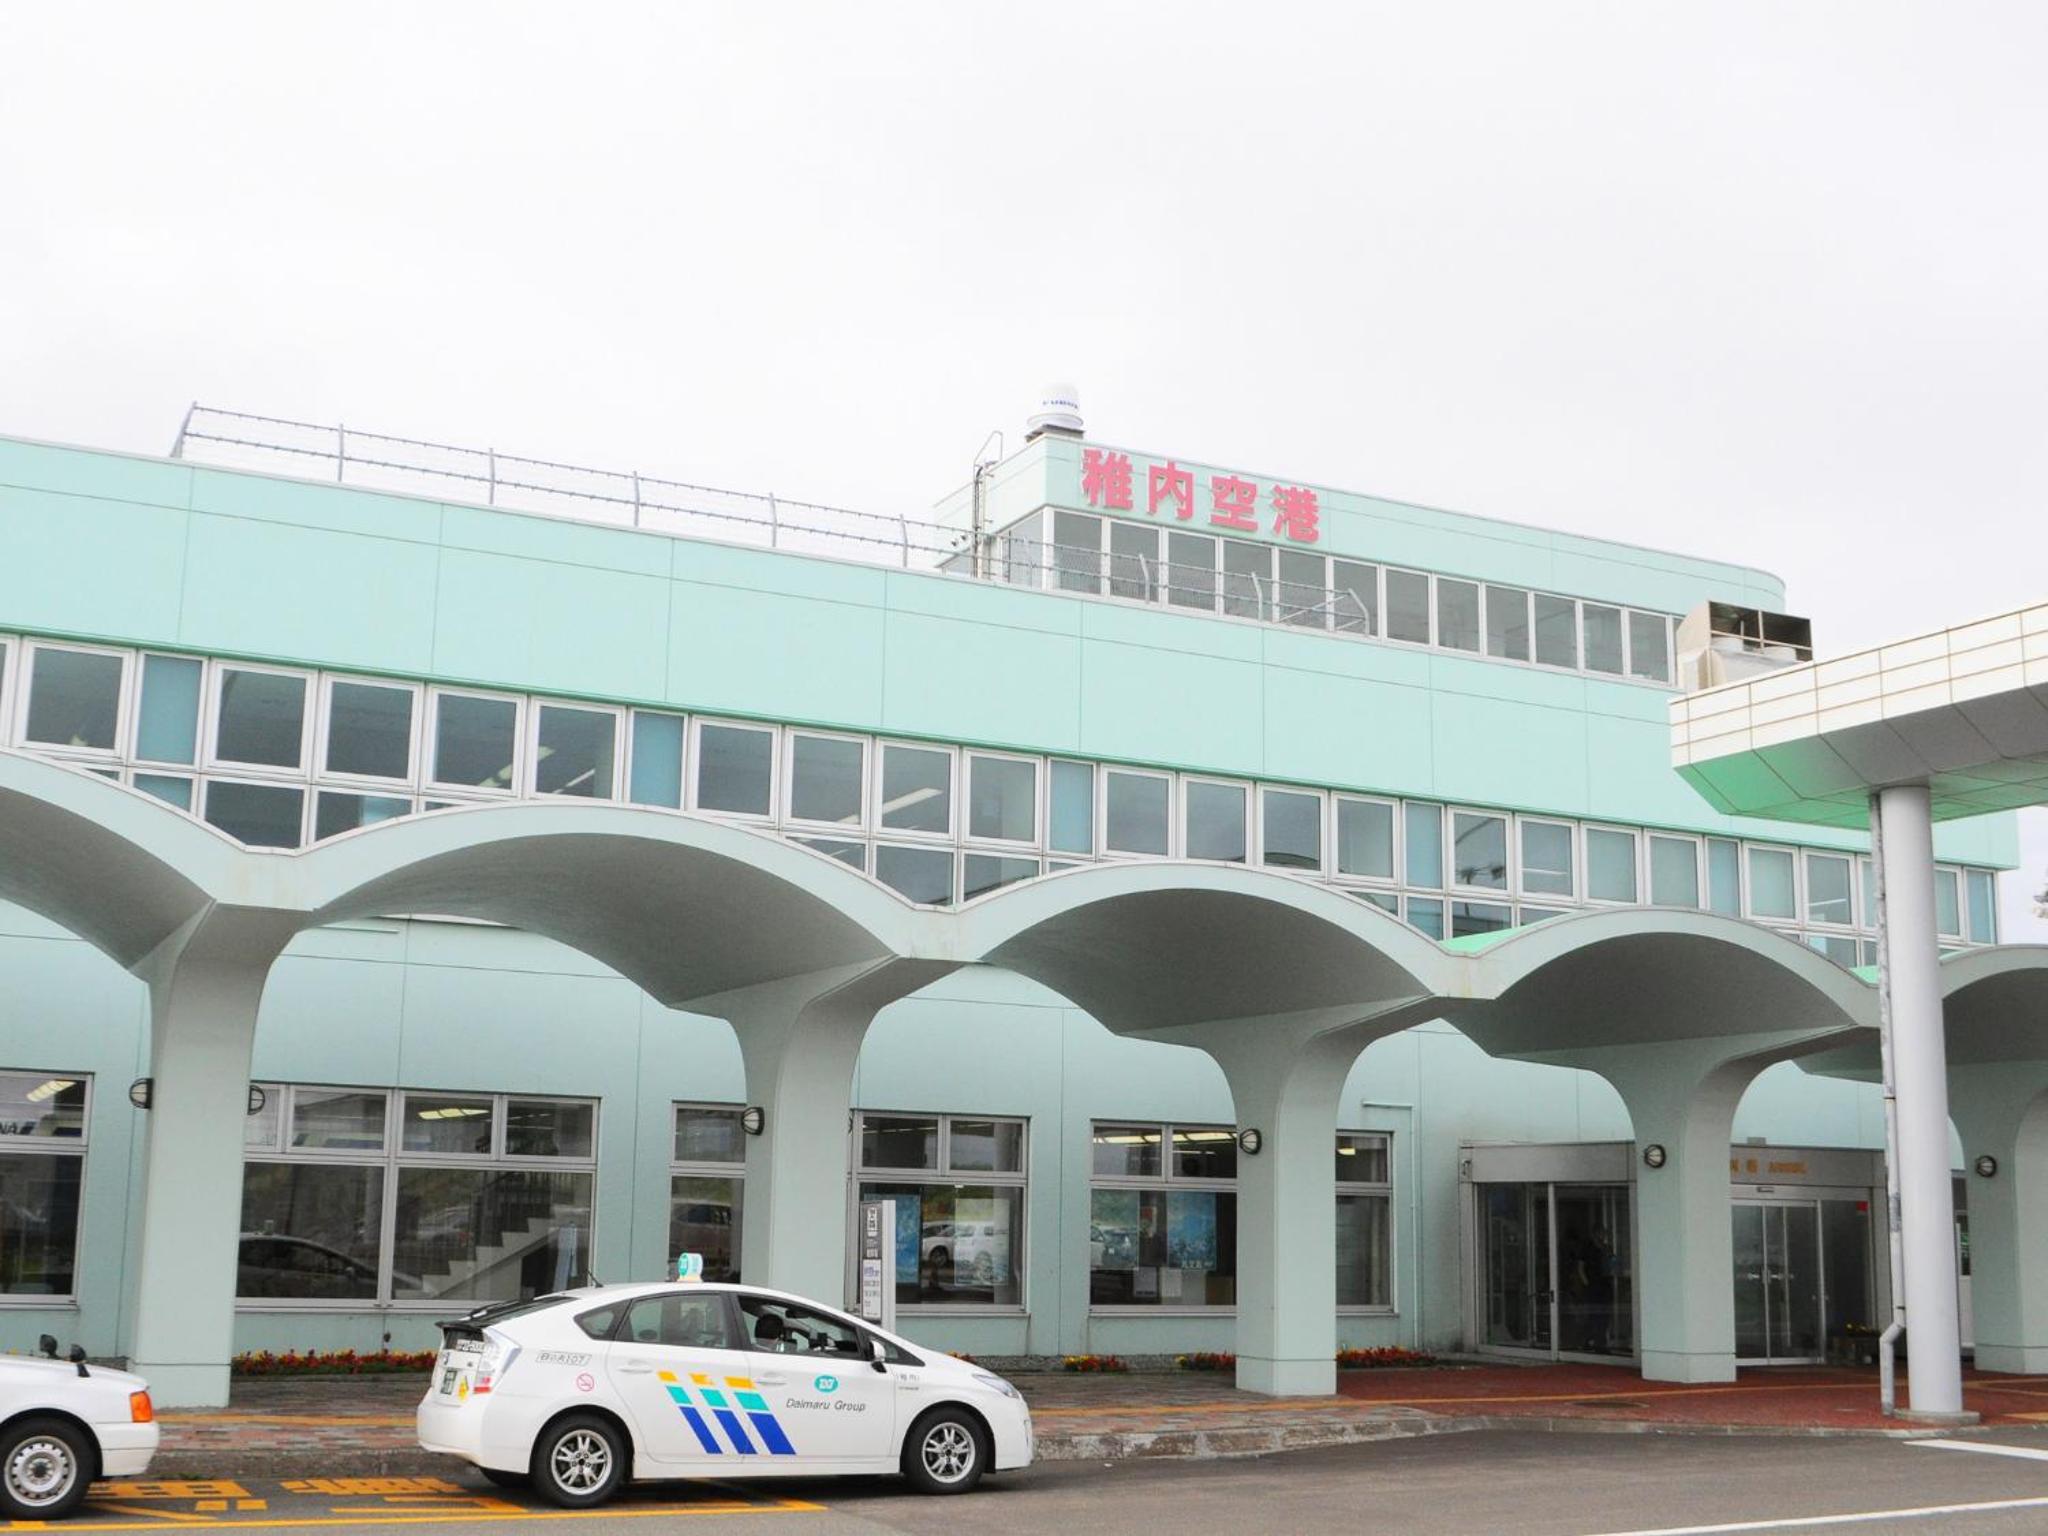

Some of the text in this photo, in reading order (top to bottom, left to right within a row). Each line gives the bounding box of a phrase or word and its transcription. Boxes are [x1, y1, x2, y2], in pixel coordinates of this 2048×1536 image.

[1080, 448, 1319, 542] 稚内空港
[786, 1398, 867, 1412] Daimaru Group
